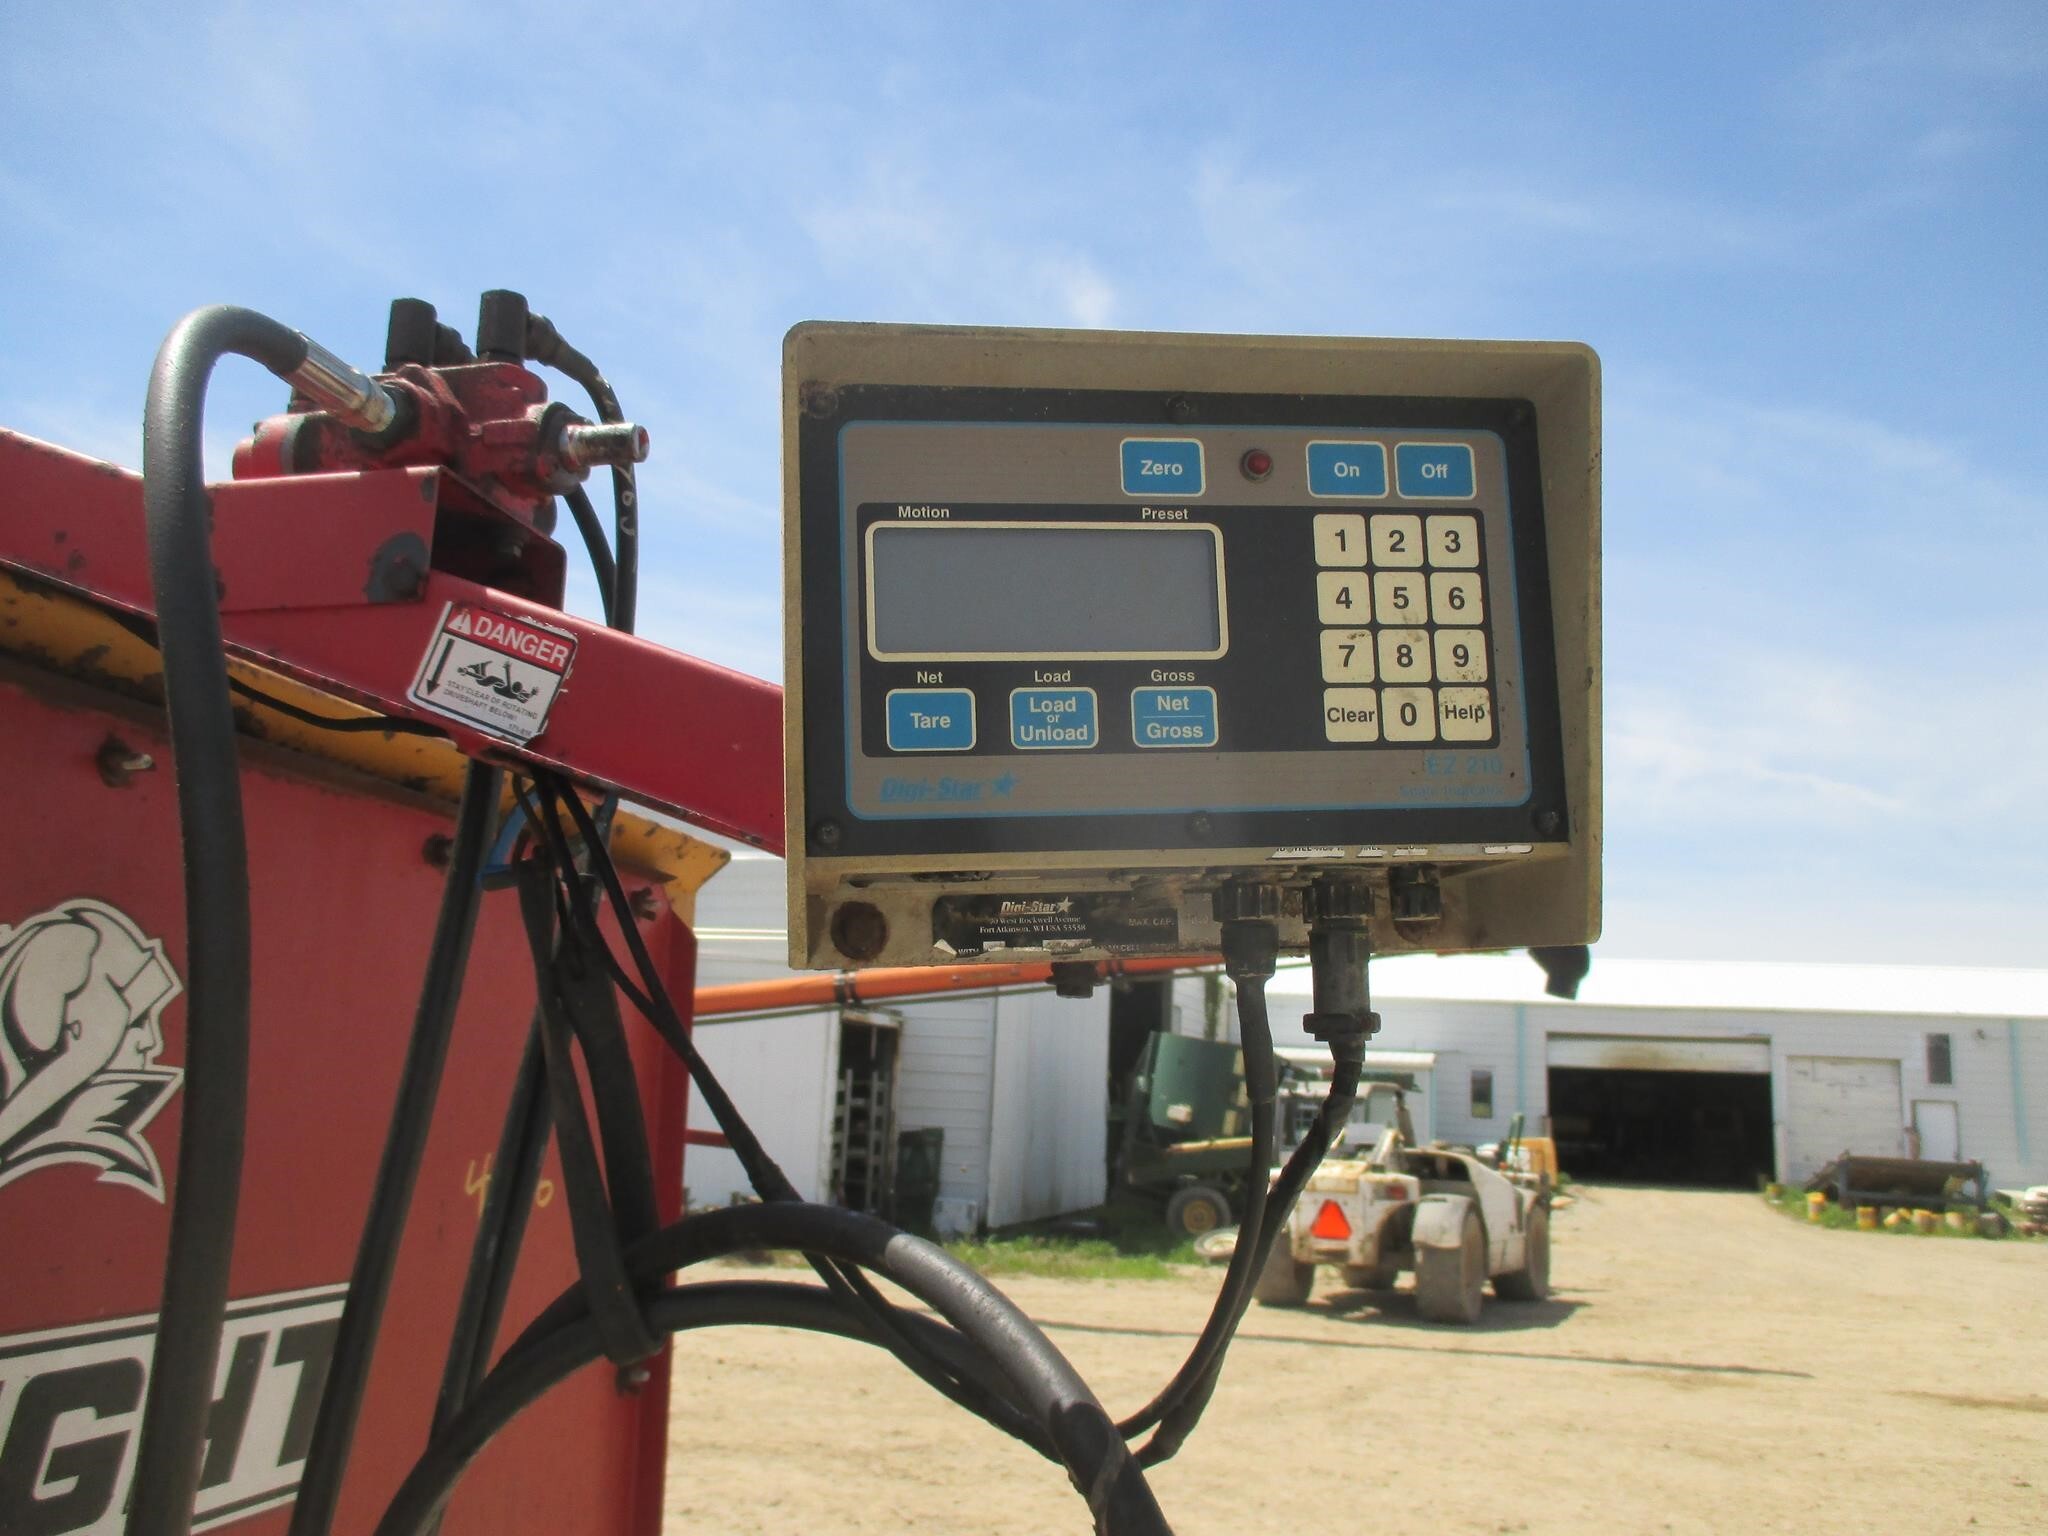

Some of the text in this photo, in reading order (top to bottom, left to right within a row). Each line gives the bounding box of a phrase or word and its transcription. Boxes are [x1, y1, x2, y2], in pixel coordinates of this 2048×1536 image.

[1140, 460, 1183, 476] Zero
[1333, 462, 1361, 478] On
[1420, 463, 1448, 479] Off
[898, 505, 950, 519] Motion
[1141, 507, 1189, 520] Preset
[1334, 528, 1462, 553] 1 2 3
[1335, 586, 1466, 610] 4 5 6
[472, 616, 569, 668] DANGER
[1338, 643, 1470, 668] 7 8 9
[916, 671, 943, 684] Net
[1033, 670, 1071, 683] Load
[1150, 669, 1196, 682] Gross
[466, 687, 490, 701] CLEAR
[1029, 696, 1077, 712] Load
[1156, 695, 1190, 711] Net
[909, 712, 951, 729] Tare
[1046, 713, 1060, 723] or
[1326, 702, 1485, 727] Clear 0 Help
[1019, 724, 1088, 742] Unload
[1146, 722, 1204, 739] Gross
[880, 777, 983, 804] Digi-Star
[1000, 901, 1056, 914] Digi-Star
[1019, 915, 1053, 924] Rockwell
[979, 926, 995, 934] Fort
